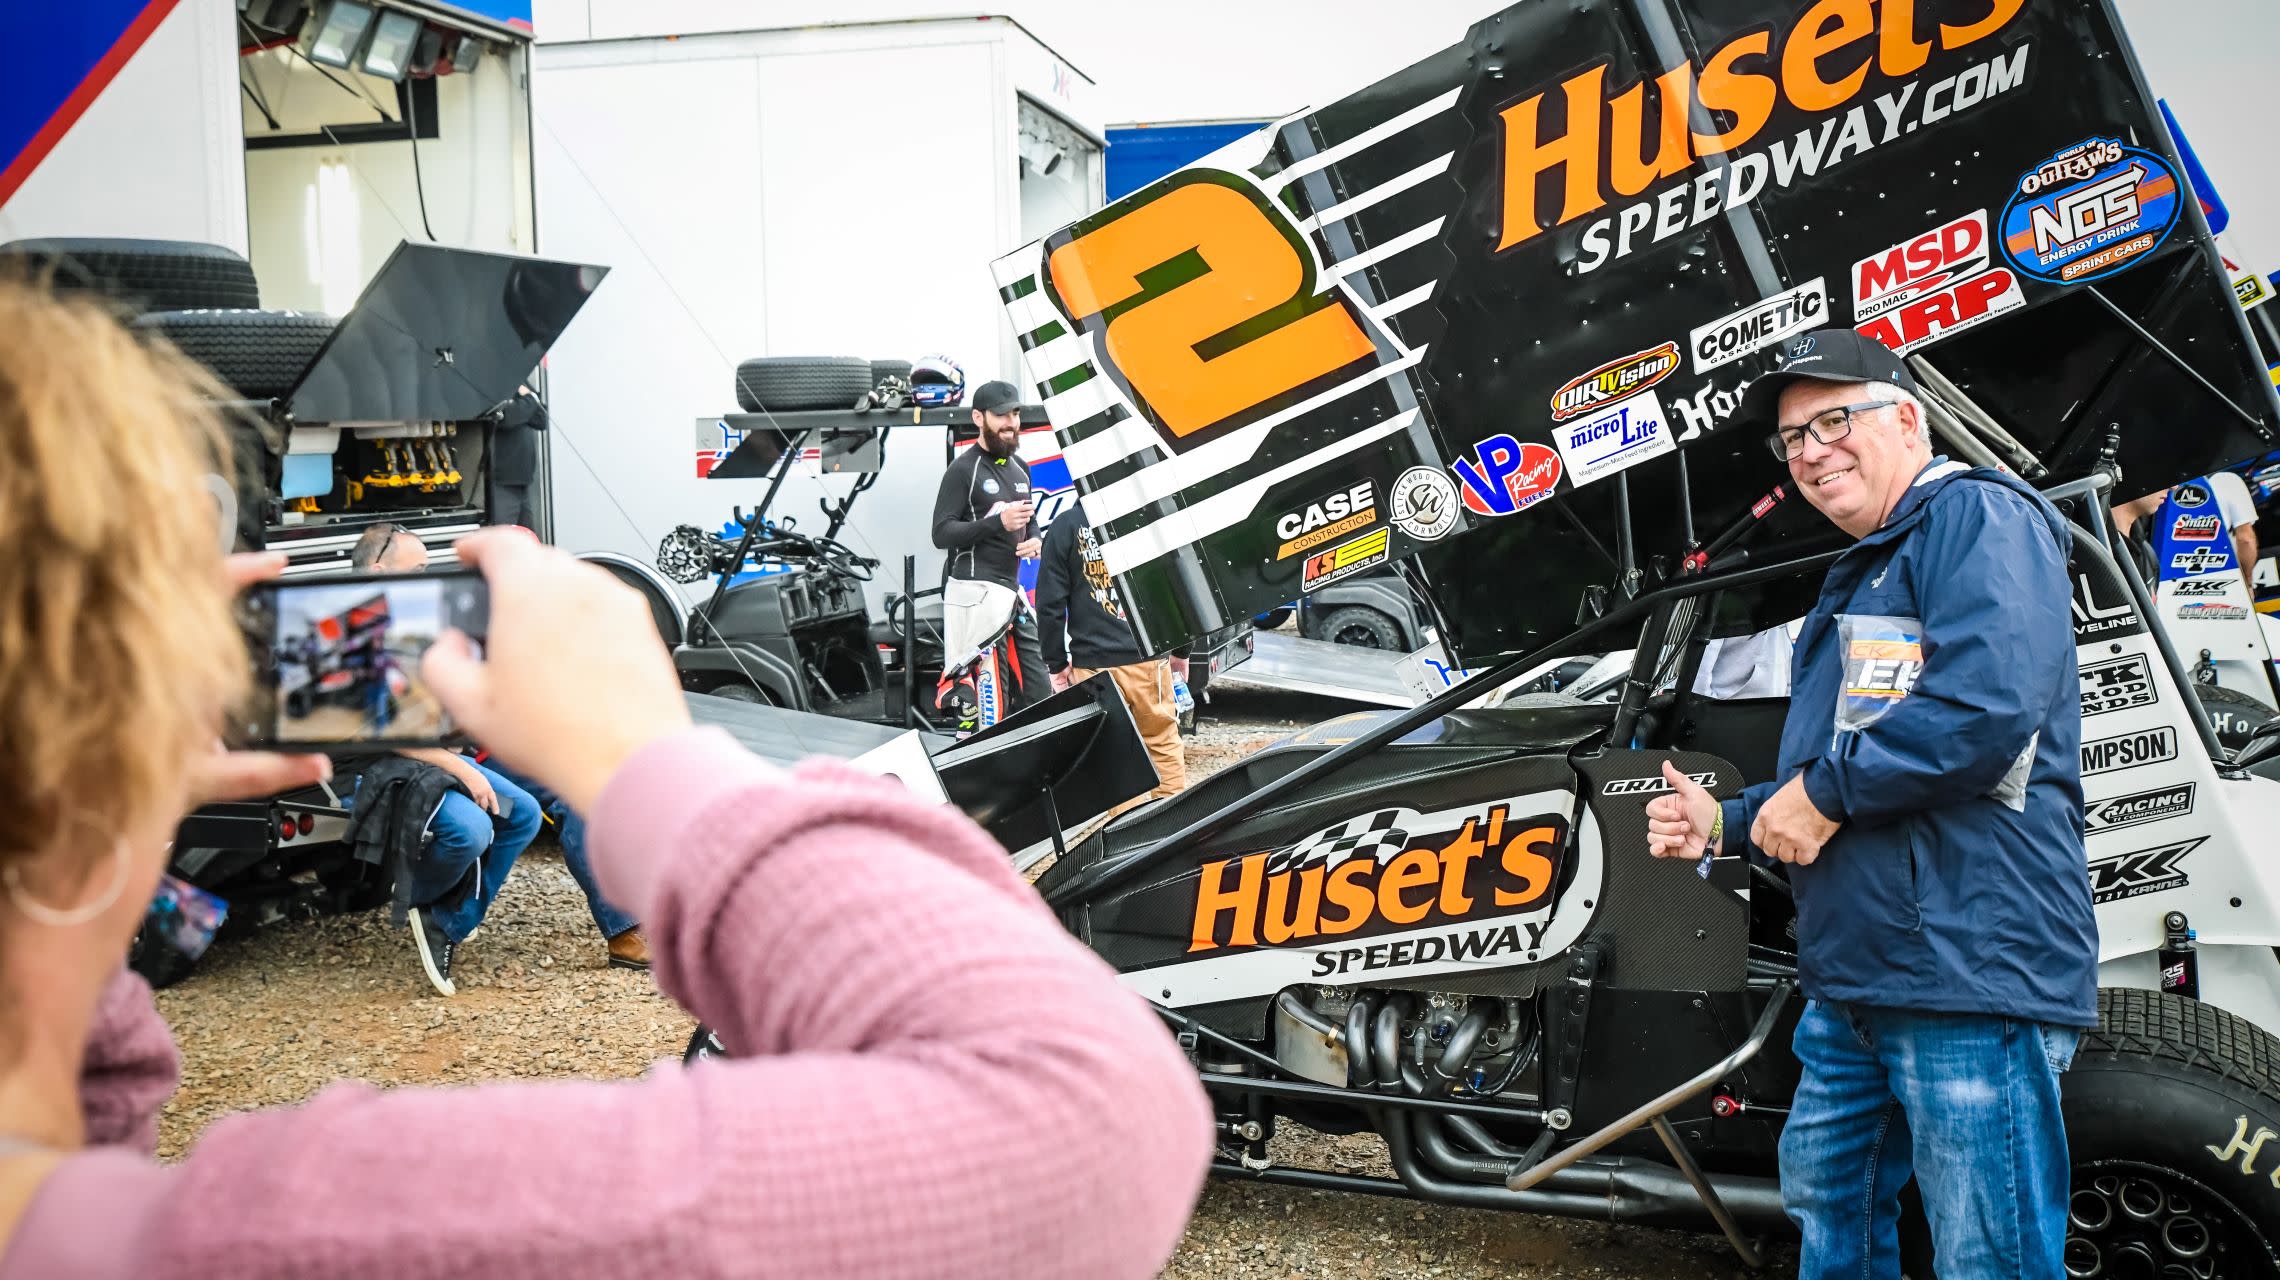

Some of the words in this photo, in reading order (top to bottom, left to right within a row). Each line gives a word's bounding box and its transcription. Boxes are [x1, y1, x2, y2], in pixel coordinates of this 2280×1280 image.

[1577, 44, 2029, 275] SPEEDWAY.COM
[2021, 141, 2122, 194] OUTLAWS
[2058, 146, 2086, 161] WORLD
[2086, 139, 2098, 149] OF
[2031, 163, 2147, 254] NOS
[1860, 219, 1982, 301] MSD
[2040, 237, 2093, 266] ENERGY
[2097, 219, 2140, 244] DRINK
[2064, 253, 2112, 278] SPRINT
[2114, 236, 2151, 258] CARS
[1050, 183, 1377, 437] 2
[1699, 290, 1821, 360] COMETIC
[1856, 270, 2012, 350] ARP
[1858, 303, 1881, 319] PRO
[1882, 292, 1908, 309] MAG
[1710, 341, 1759, 364] GASKET
[1905, 335, 1935, 351] products
[1453, 435, 1522, 514] VP
[1510, 455, 1557, 499] Racing
[1277, 481, 1374, 540] CASE
[1518, 488, 1552, 507] FUELS
[1293, 511, 1373, 550] CONSTRUCTION
[2174, 555, 2227, 563] SYSTEM
[1304, 574, 1331, 590] RACING
[1603, 774, 1716, 793] GRAEL
[2105, 792, 2187, 820] RACING
[2123, 804, 2186, 822] COMPONENTS
[1187, 809, 1556, 953] Huset's
[2128, 878, 2182, 896] KAHNE
[1311, 922, 1549, 978] SPEEDWAY
